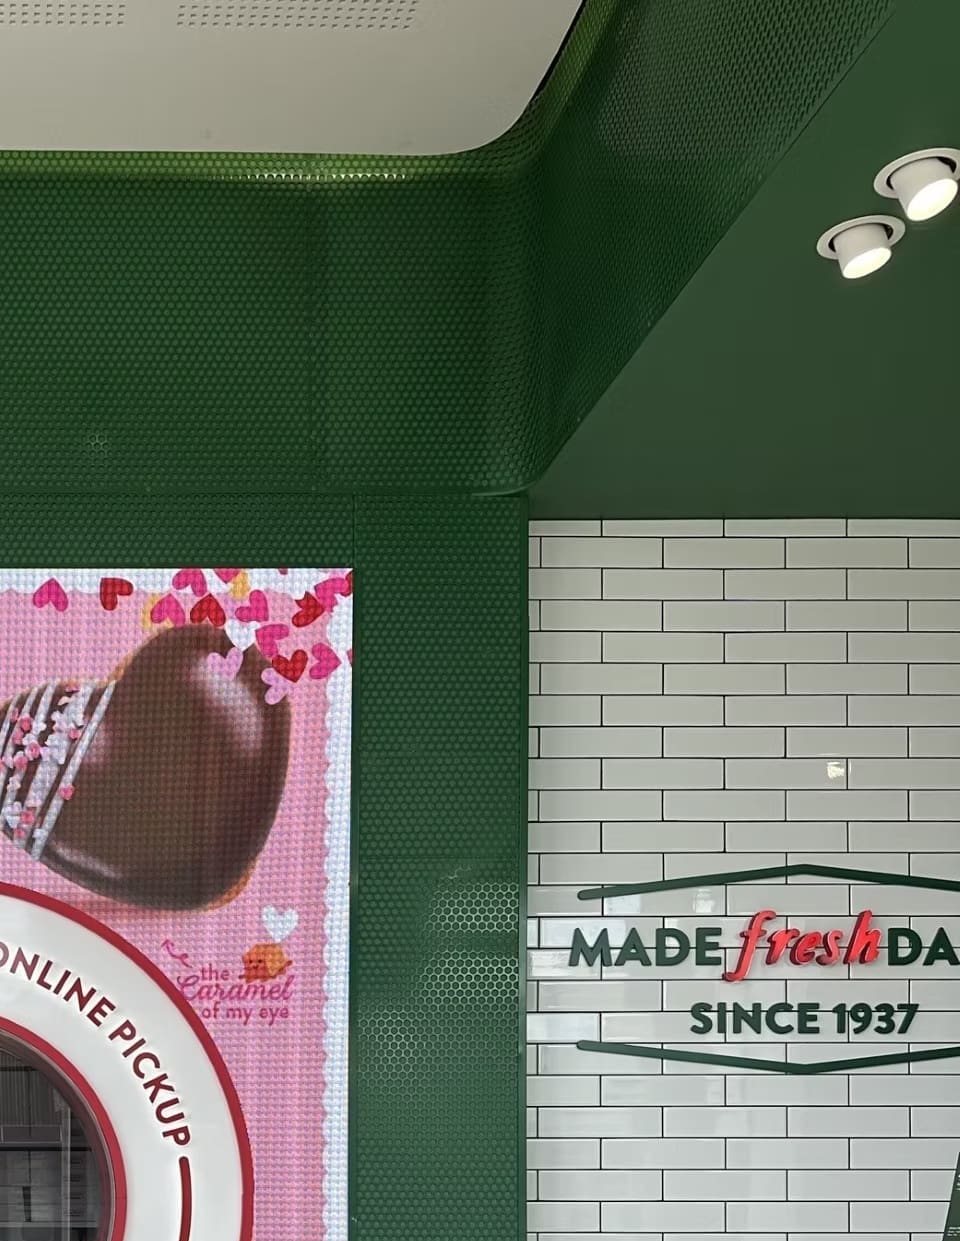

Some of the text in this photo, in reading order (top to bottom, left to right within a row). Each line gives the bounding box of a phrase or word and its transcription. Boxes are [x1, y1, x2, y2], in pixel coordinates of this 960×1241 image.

[568, 927, 722, 967] MADE
[722, 909, 882, 982] fresh
[200, 963, 230, 981] the
[177, 975, 295, 1001] Caramel
[201, 1001, 289, 1026] of my eye
[690, 1002, 920, 1035] SINCE 1937
[108, 1019, 191, 1146] PICKUP
